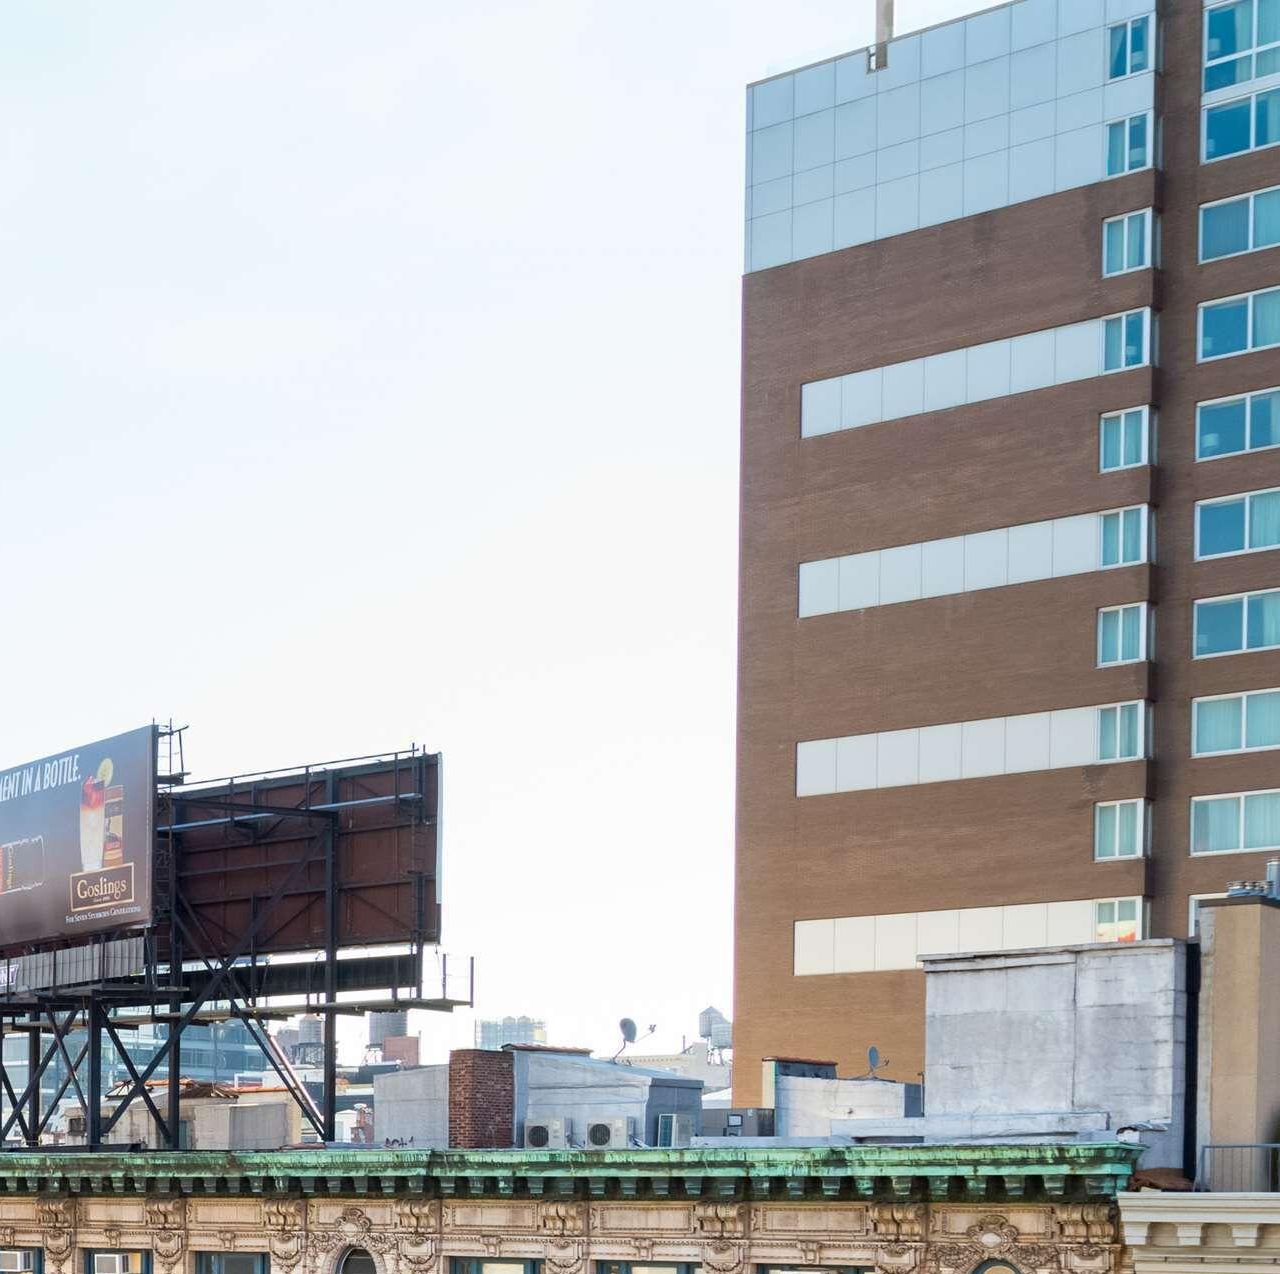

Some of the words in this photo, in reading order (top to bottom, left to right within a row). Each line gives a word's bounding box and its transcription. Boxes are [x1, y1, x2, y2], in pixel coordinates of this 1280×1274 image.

[21, 766, 34, 795] IN
[34, 765, 41, 792] A
[43, 755, 81, 789] BOTTLE.
[77, 877, 127, 899] Goslings
